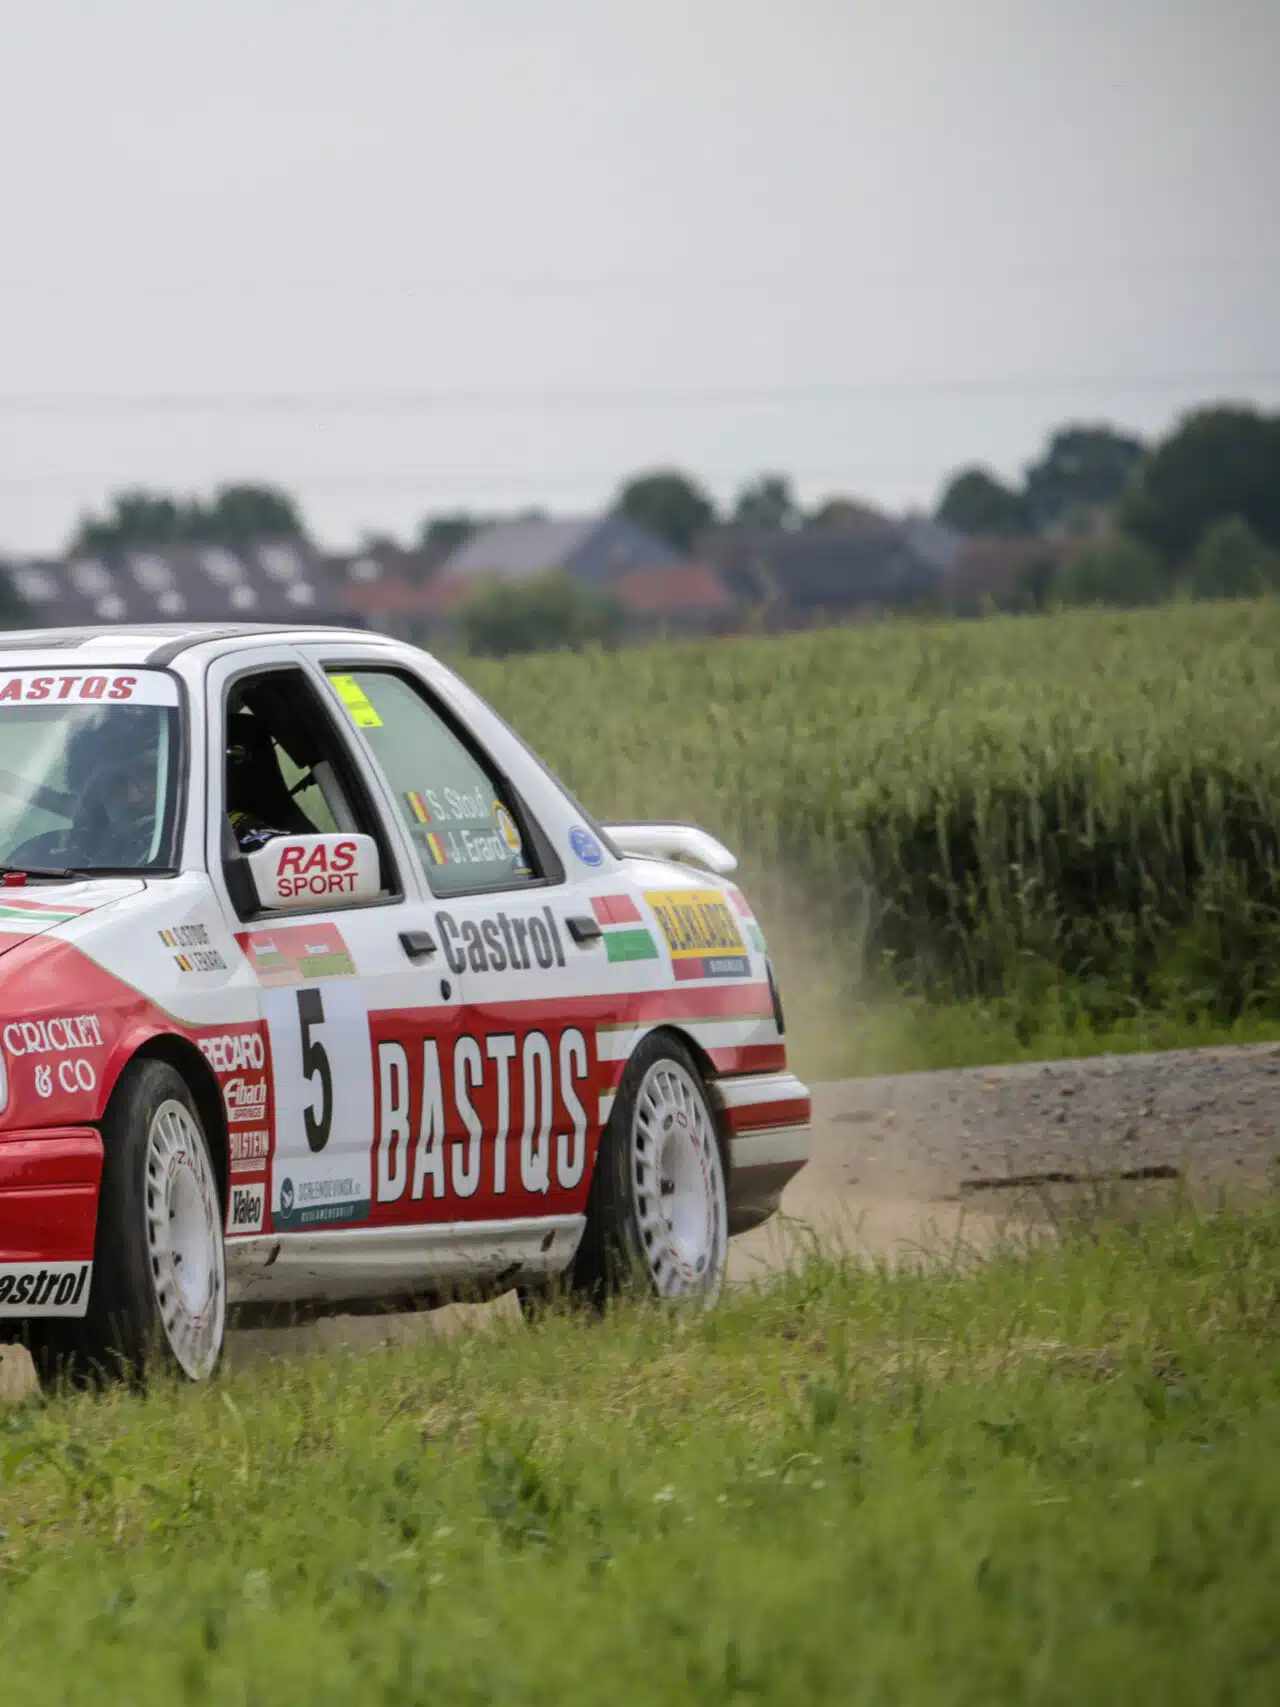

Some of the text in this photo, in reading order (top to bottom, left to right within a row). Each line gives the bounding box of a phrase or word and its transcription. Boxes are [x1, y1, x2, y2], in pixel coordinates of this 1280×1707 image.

[277, 842, 357, 876] RAS
[277, 872, 359, 898] SPORT
[435, 906, 565, 975] Castrol
[4, 1015, 104, 1057] CRICKET
[34, 1059, 96, 1097] & CO
[296, 988, 332, 1152] 5
[233, 1189, 261, 1225] Valeo
